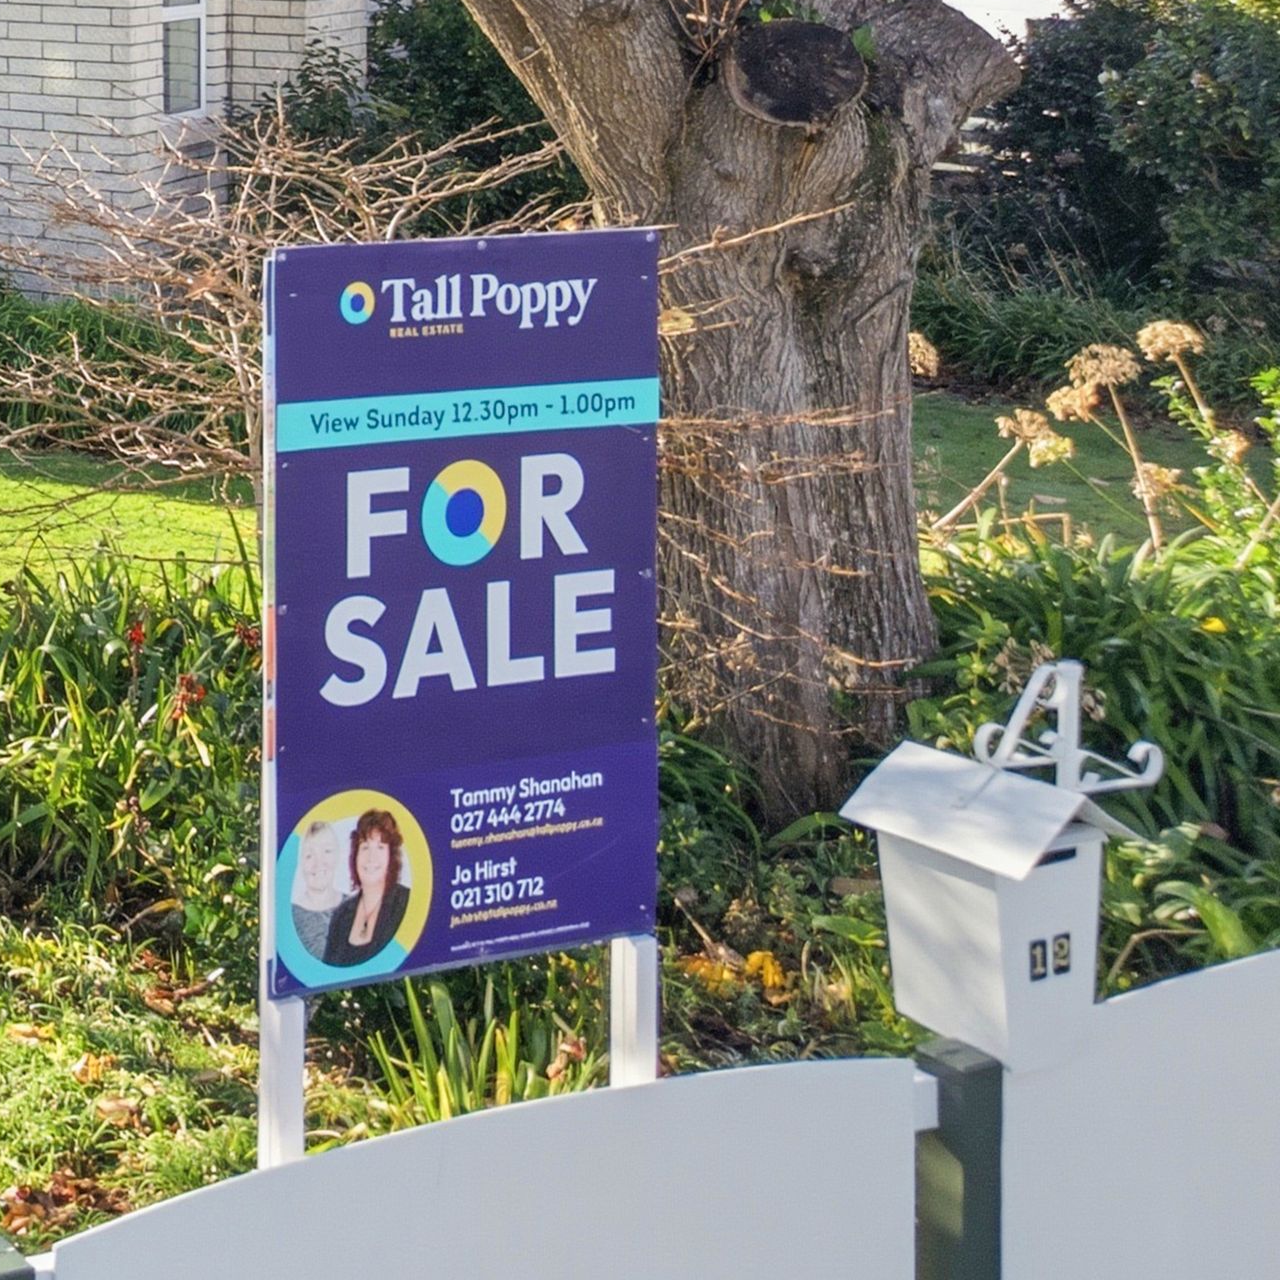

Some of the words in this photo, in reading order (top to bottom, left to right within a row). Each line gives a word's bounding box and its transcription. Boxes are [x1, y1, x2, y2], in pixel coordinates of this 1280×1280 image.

[381, 273, 461, 323] Tall
[470, 273, 598, 329] Poppy
[389, 326, 419, 339] REAL
[422, 323, 464, 337] ESTATE
[310, 410, 359, 435] View
[367, 404, 445, 432] Sunday
[452, 399, 539, 428] 12.30pm
[560, 393, 636, 420] 1.00pm
[346, 453, 589, 579] FOR
[319, 569, 616, 706] SALE
[450, 784, 516, 809] Tammy
[519, 770, 603, 799] Shanahan
[450, 810, 484, 833] 027
[487, 806, 521, 827] 444
[524, 797, 565, 823] 2774
[451, 865, 472, 886] Jo
[475, 856, 517, 881] Hirst
[450, 888, 481, 909] 021
[484, 881, 514, 904] 310
[516, 876, 544, 899] 712
